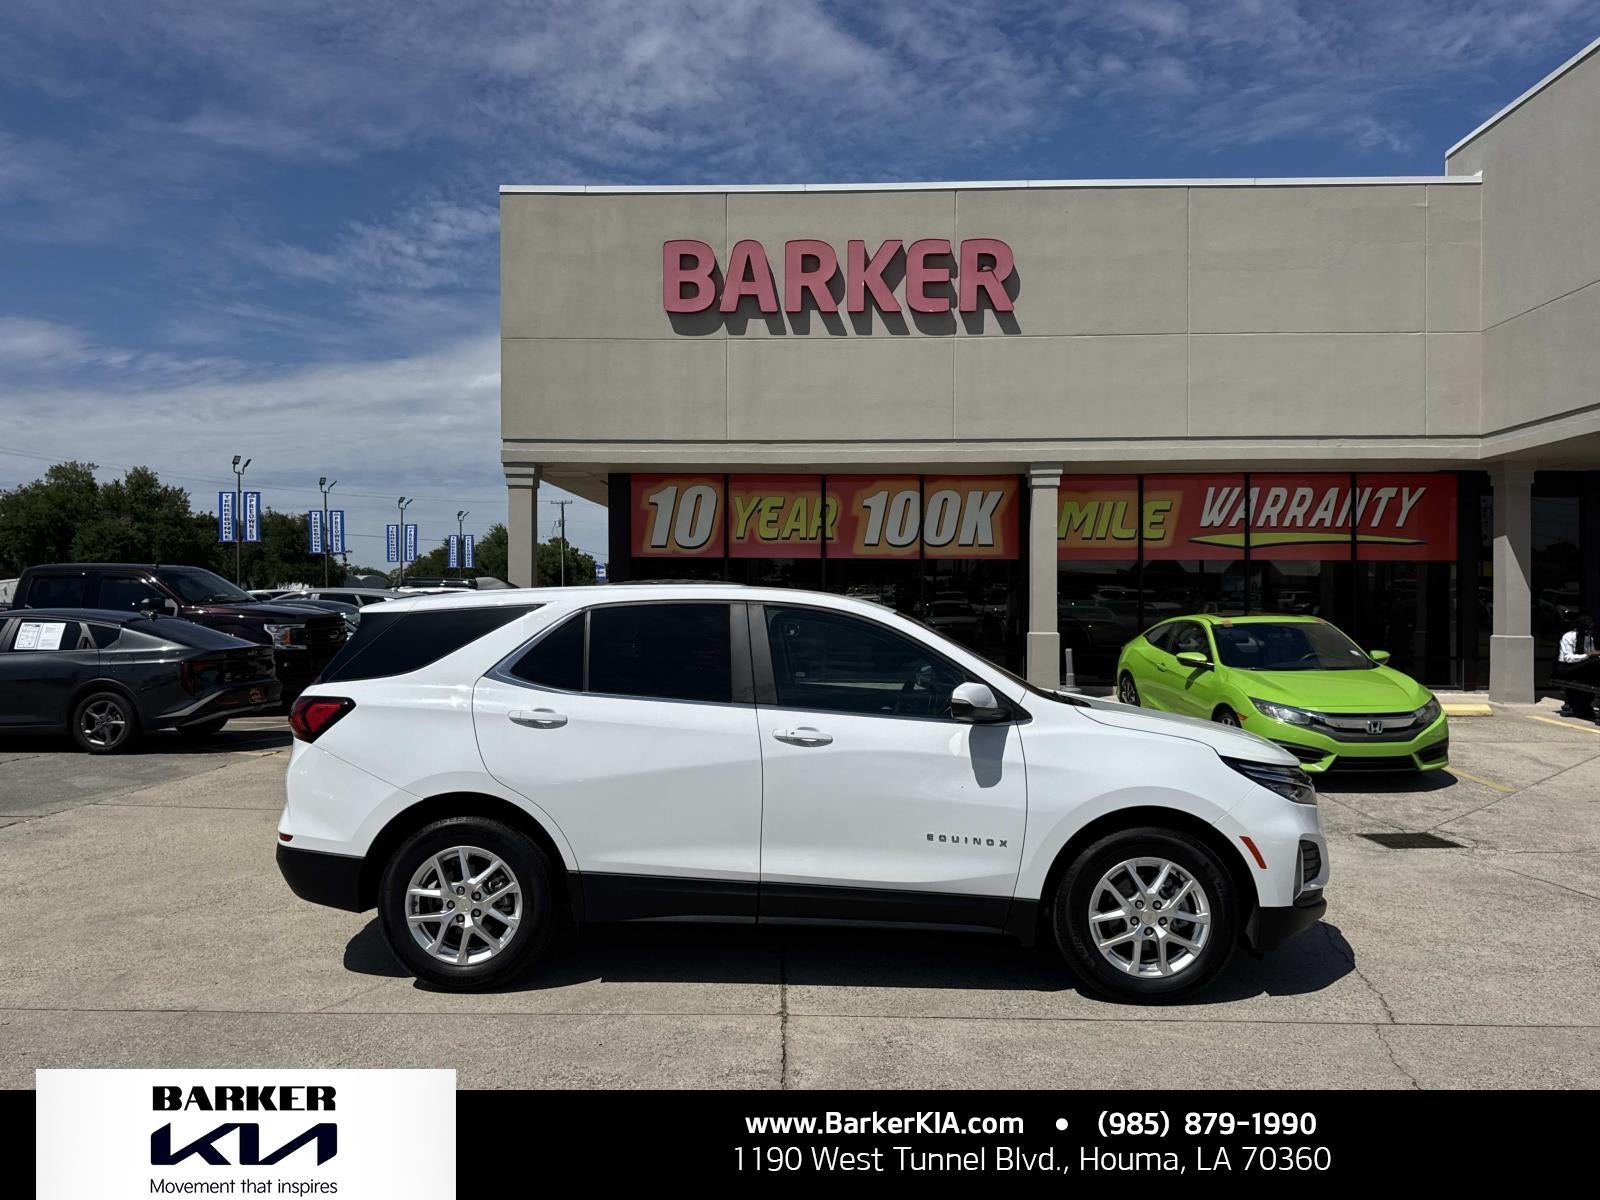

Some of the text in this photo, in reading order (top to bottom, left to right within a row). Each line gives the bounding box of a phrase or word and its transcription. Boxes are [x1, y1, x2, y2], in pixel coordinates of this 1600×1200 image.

[663, 238, 1015, 313] BARKER
[648, 485, 1428, 549] 10 YEAR 100K MILE WARRANTY
[926, 833, 1008, 848] EQUINOX
